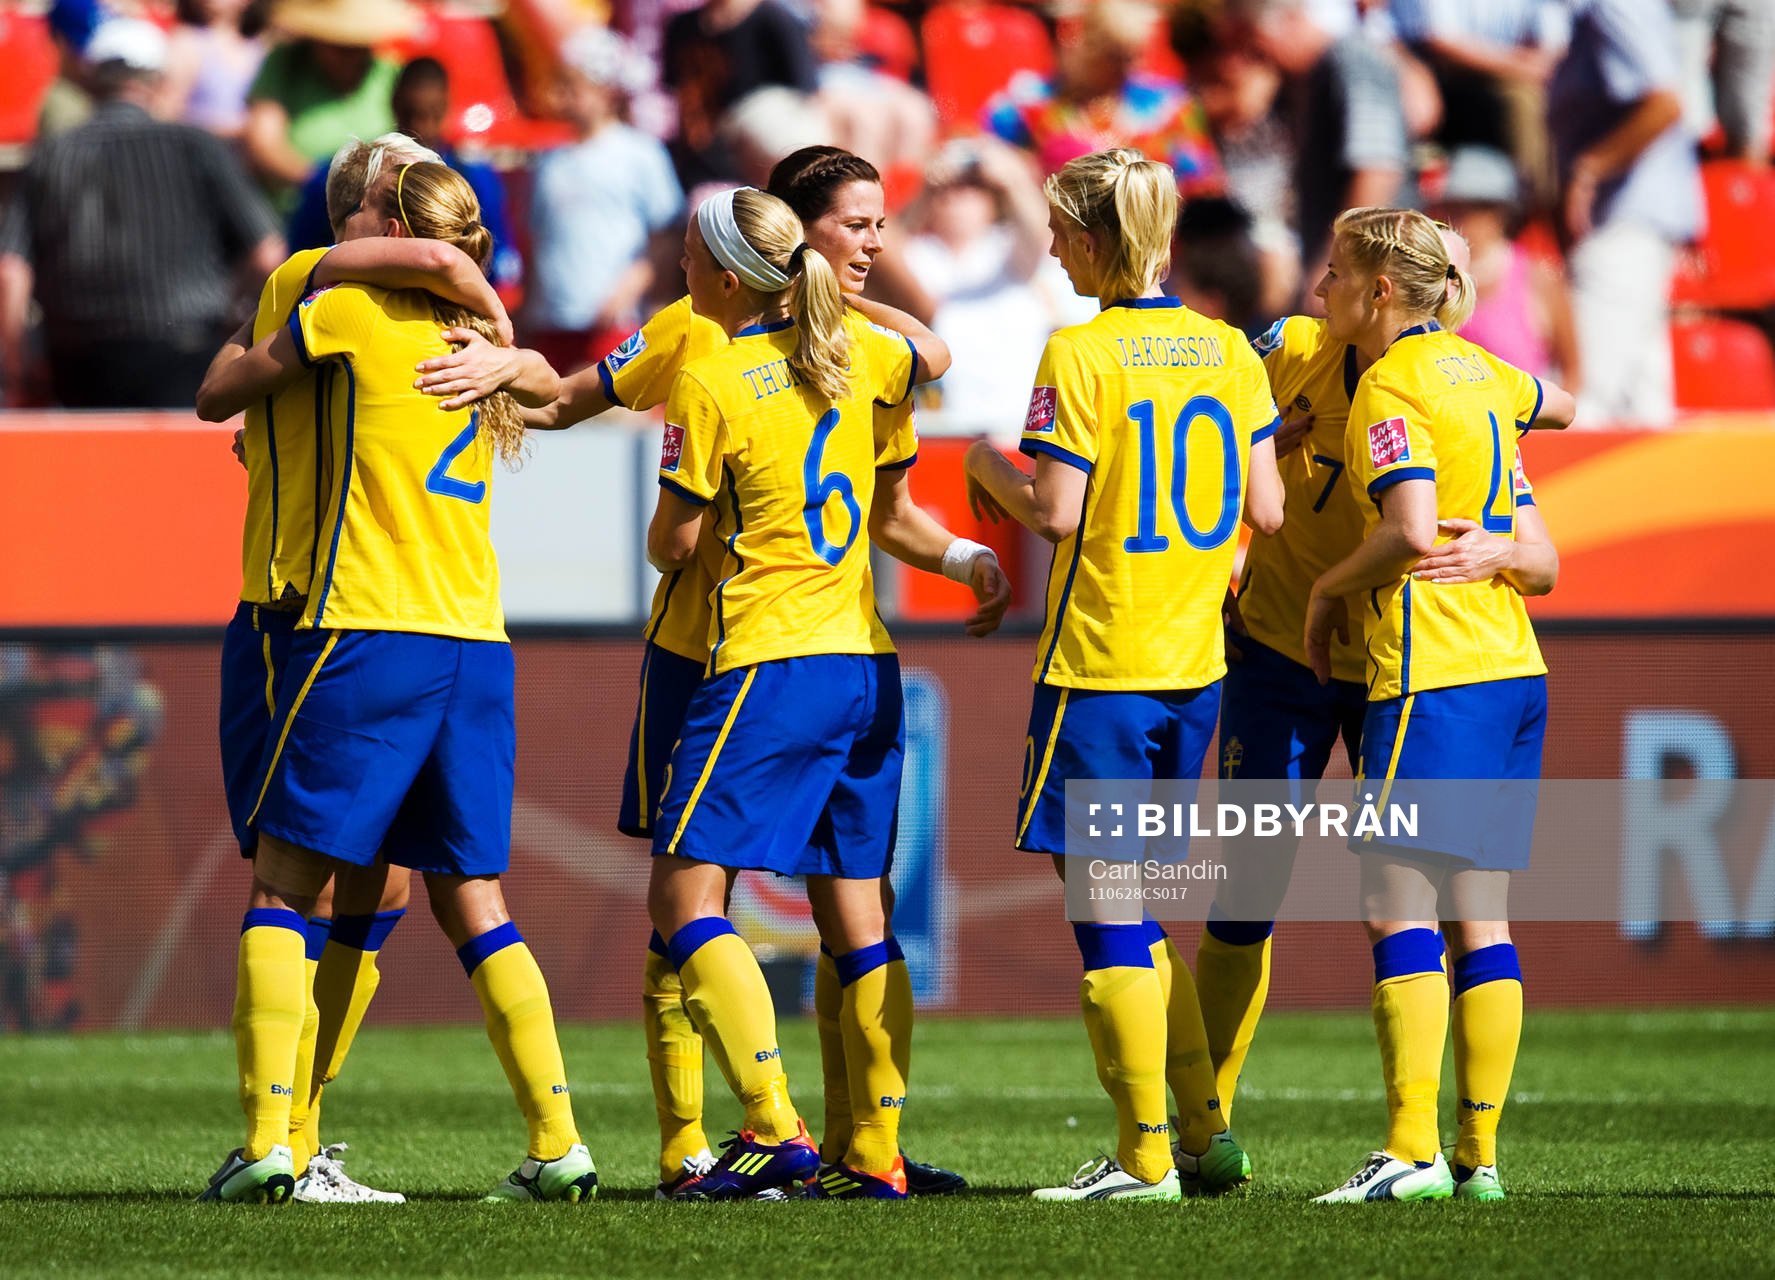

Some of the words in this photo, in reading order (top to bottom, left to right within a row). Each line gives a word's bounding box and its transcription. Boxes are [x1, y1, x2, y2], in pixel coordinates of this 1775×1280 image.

[1116, 336, 1224, 367] JAKOBSSON
[425, 409, 486, 504] 2
[1371, 421, 1394, 442] LIVE
[1372, 429, 1402, 453] YOUR
[1373, 438, 1406, 463] GOALS
[802, 408, 861, 567] 6
[1124, 395, 1241, 553] 10
[1312, 454, 1344, 513] 7
[1482, 409, 1513, 533] 4
